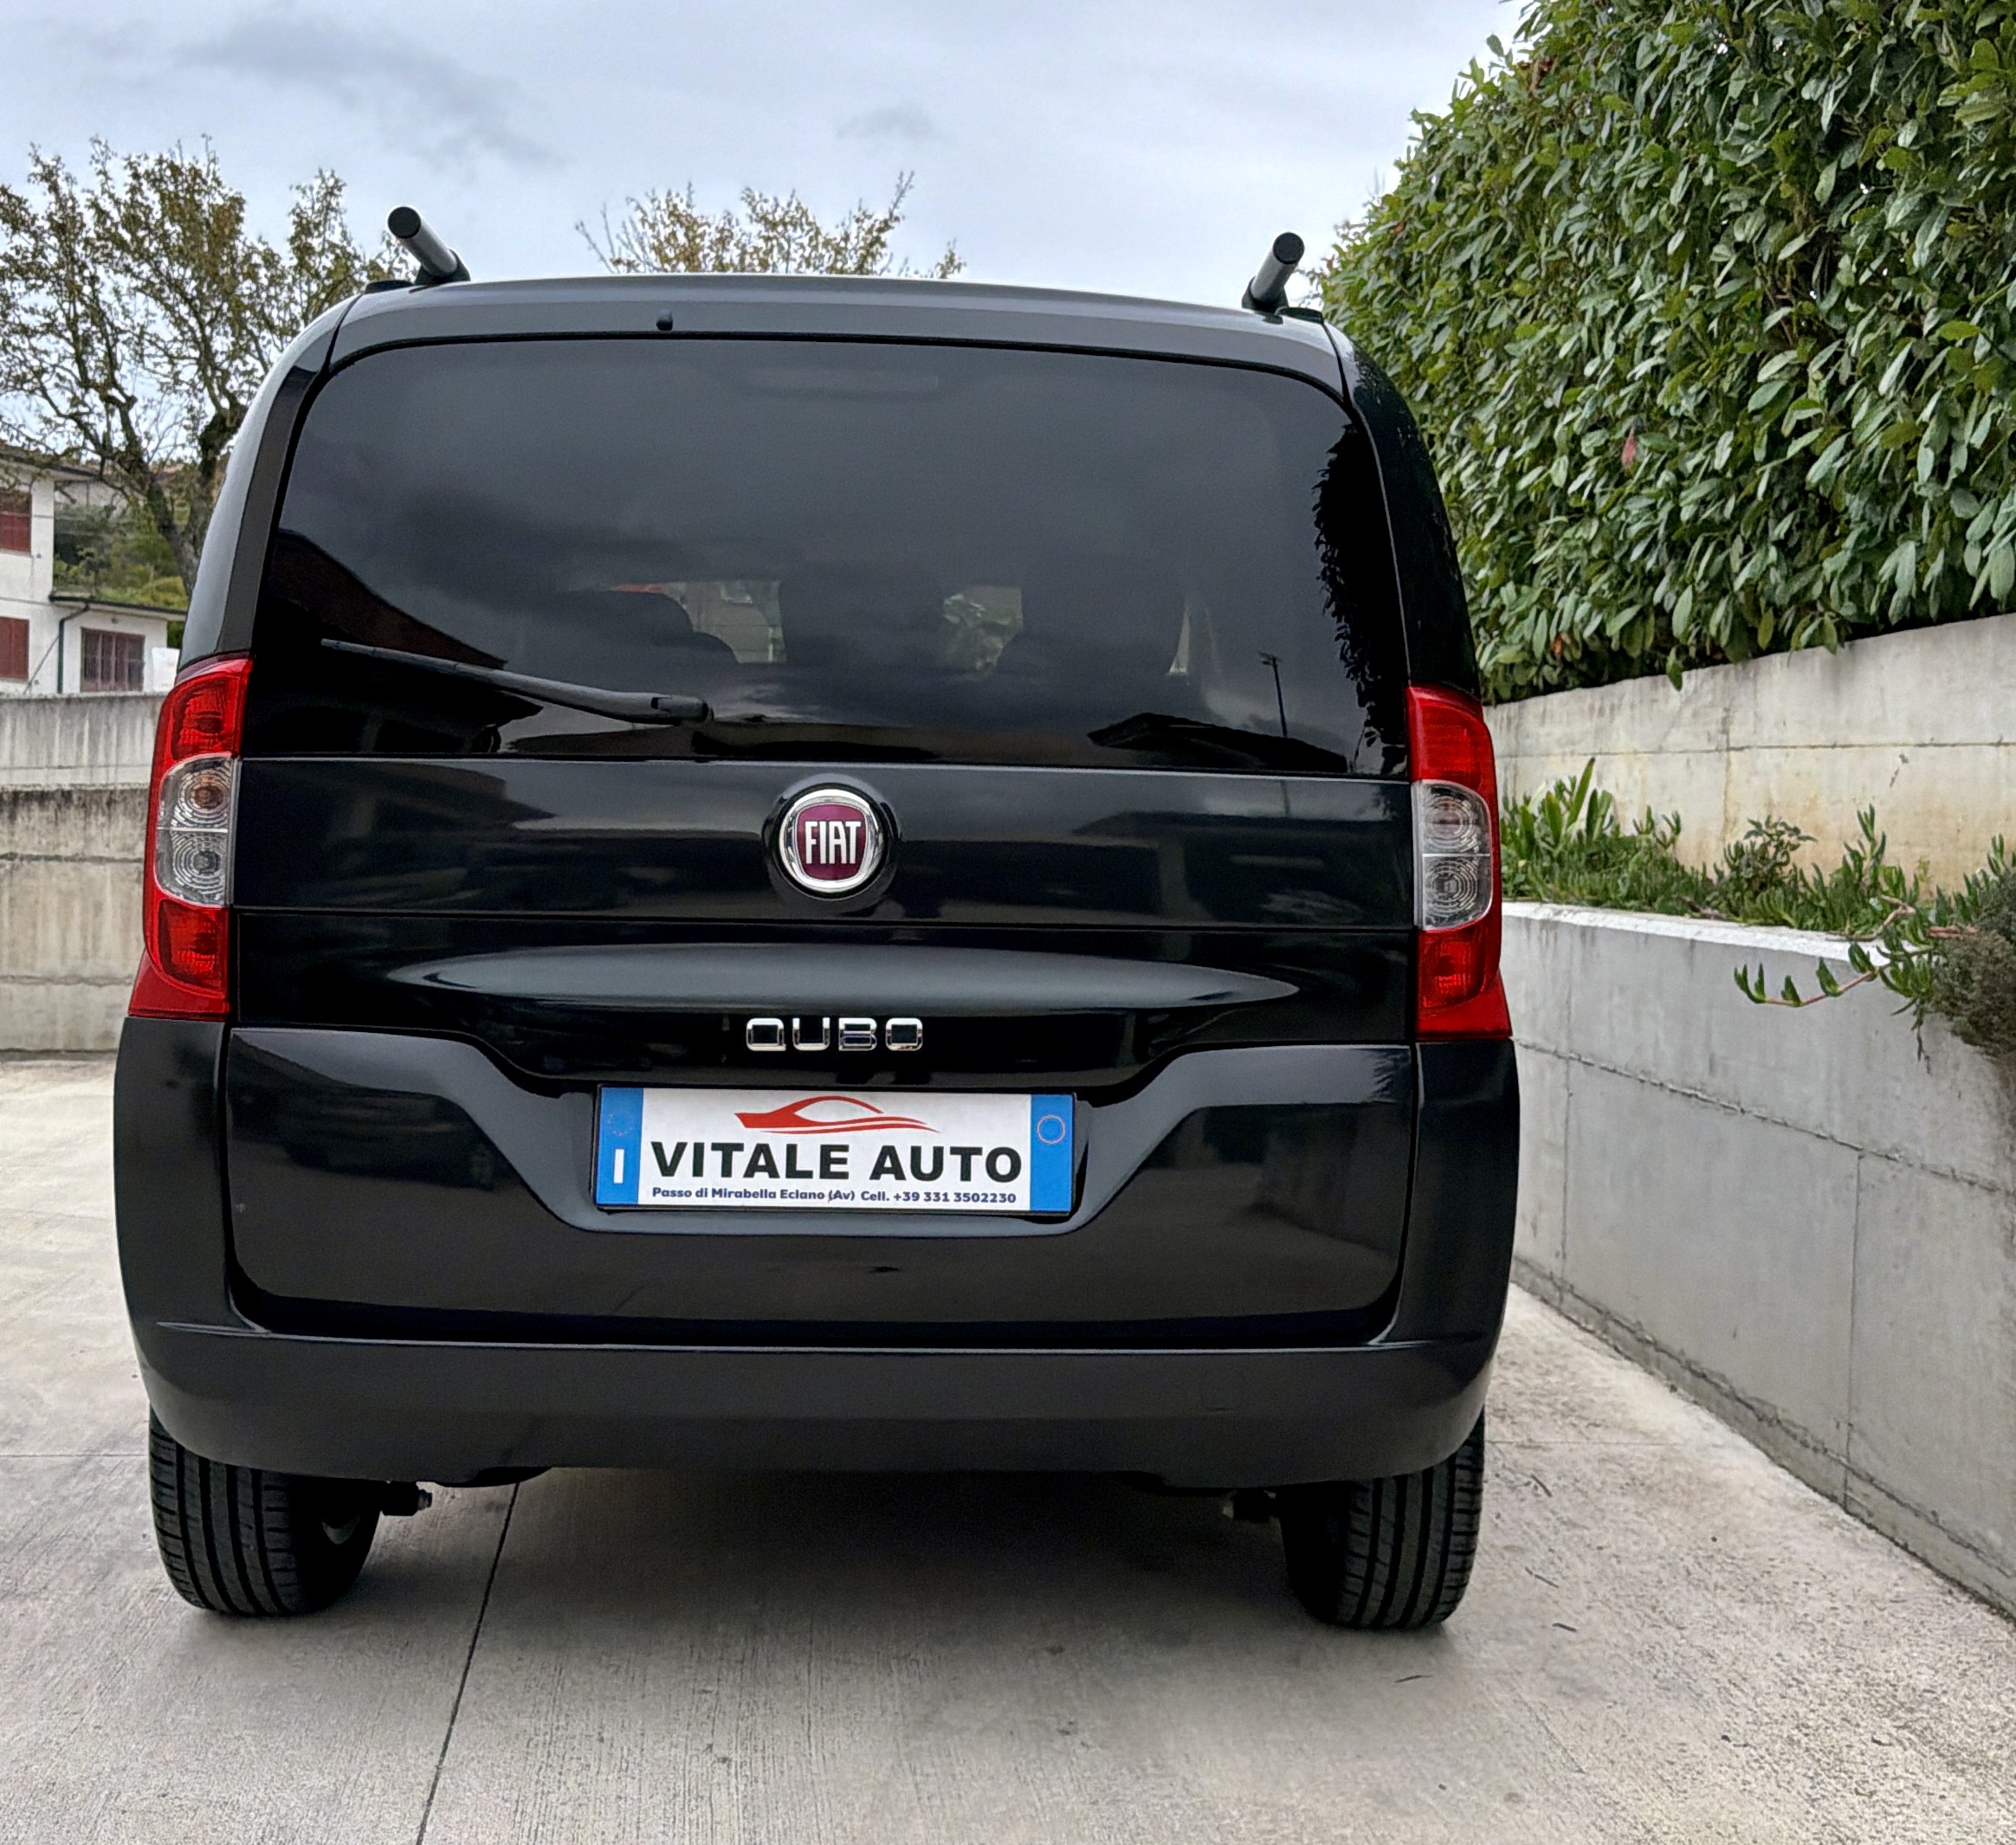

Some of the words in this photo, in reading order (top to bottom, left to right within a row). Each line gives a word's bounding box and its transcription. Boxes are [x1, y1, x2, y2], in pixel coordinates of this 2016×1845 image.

[804, 820, 862, 865] FIAT
[746, 1017, 924, 1052] QUBO
[613, 1149, 624, 1184] I
[650, 1141, 850, 1180] VITALE
[869, 1144, 1023, 1183] AUTO
[652, 1187, 692, 1198] Passo
[695, 1187, 708, 1198] di
[711, 1188, 777, 1200] Mirabella
[779, 1189, 824, 1201] Eclano
[828, 1190, 856, 1202] (Av)
[861, 1190, 890, 1202] Cell.
[894, 1191, 920, 1203] +39
[923, 1191, 950, 1203] 331
[953, 1192, 1017, 1203] 3502230
